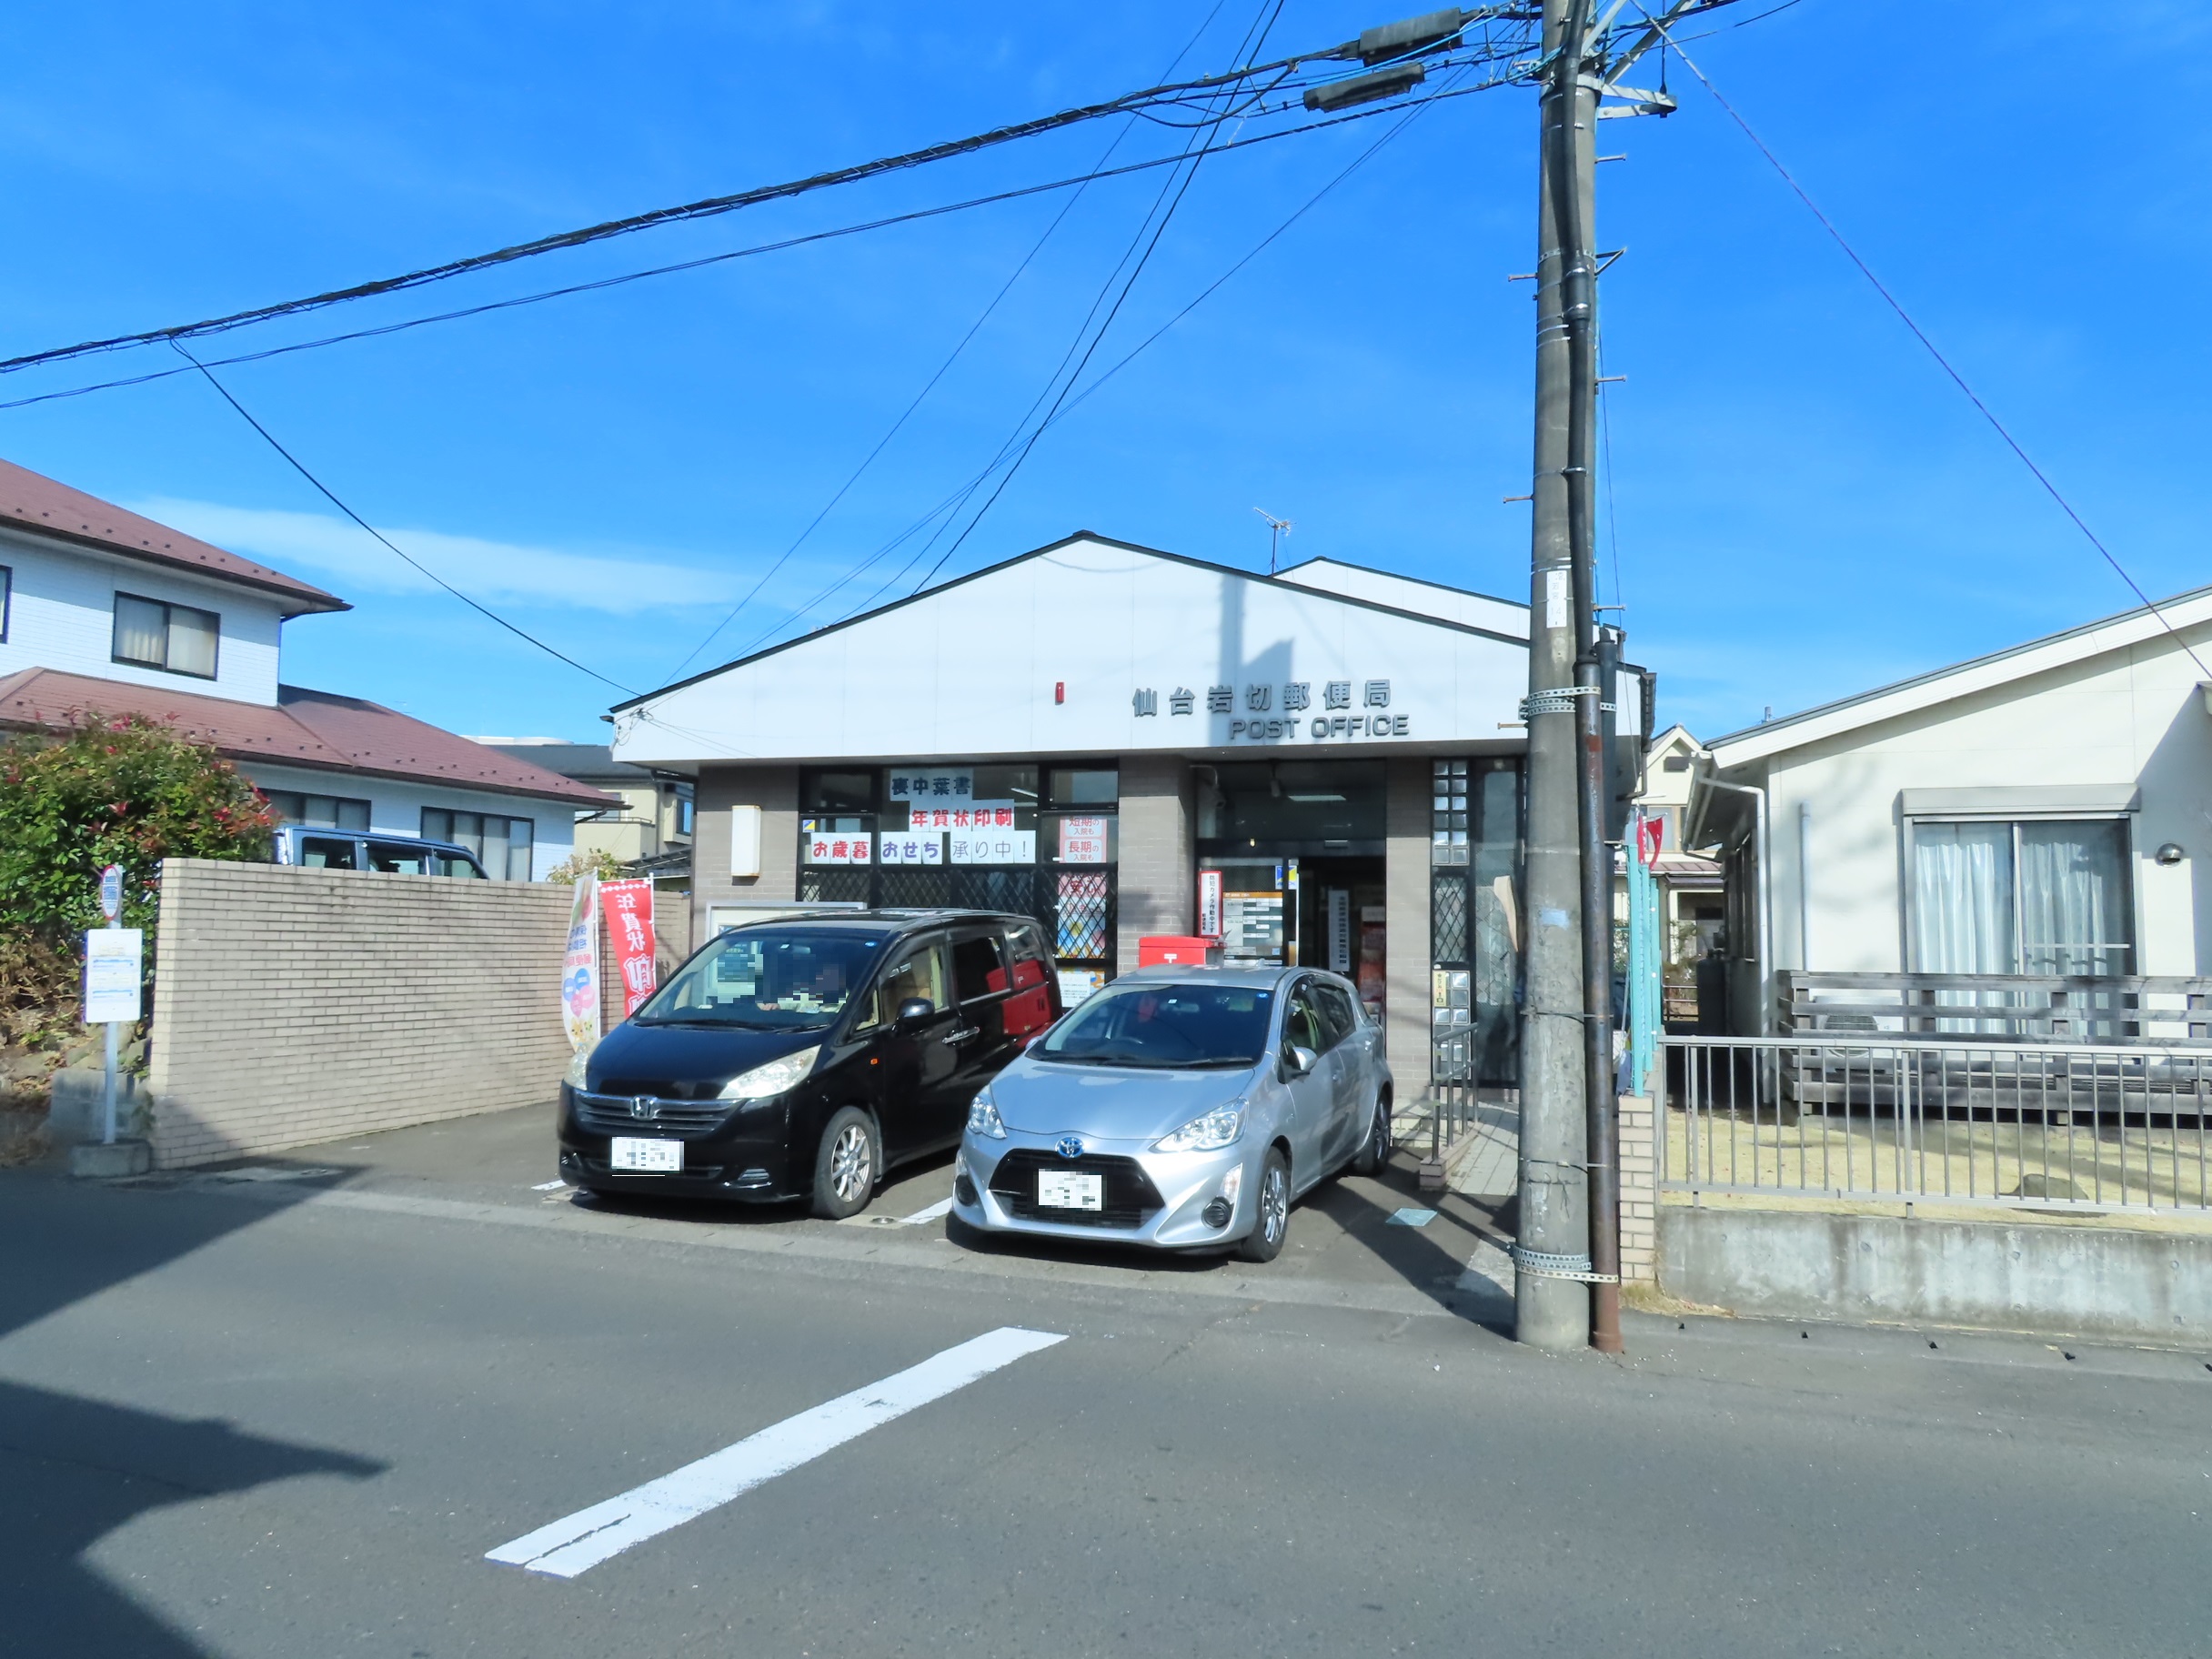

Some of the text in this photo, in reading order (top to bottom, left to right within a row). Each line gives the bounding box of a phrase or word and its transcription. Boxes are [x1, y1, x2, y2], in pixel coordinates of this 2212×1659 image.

[1132, 679, 1392, 717] 仙台岩切郵便局
[1229, 713, 1410, 739] POST OFFICE
[891, 777, 971, 796] 喪中葉書
[911, 808, 1012, 827] 年賀状印刷
[813, 840, 869, 858] お歳暮
[883, 841, 940, 859] おせち
[1069, 841, 1099, 853] 長期の
